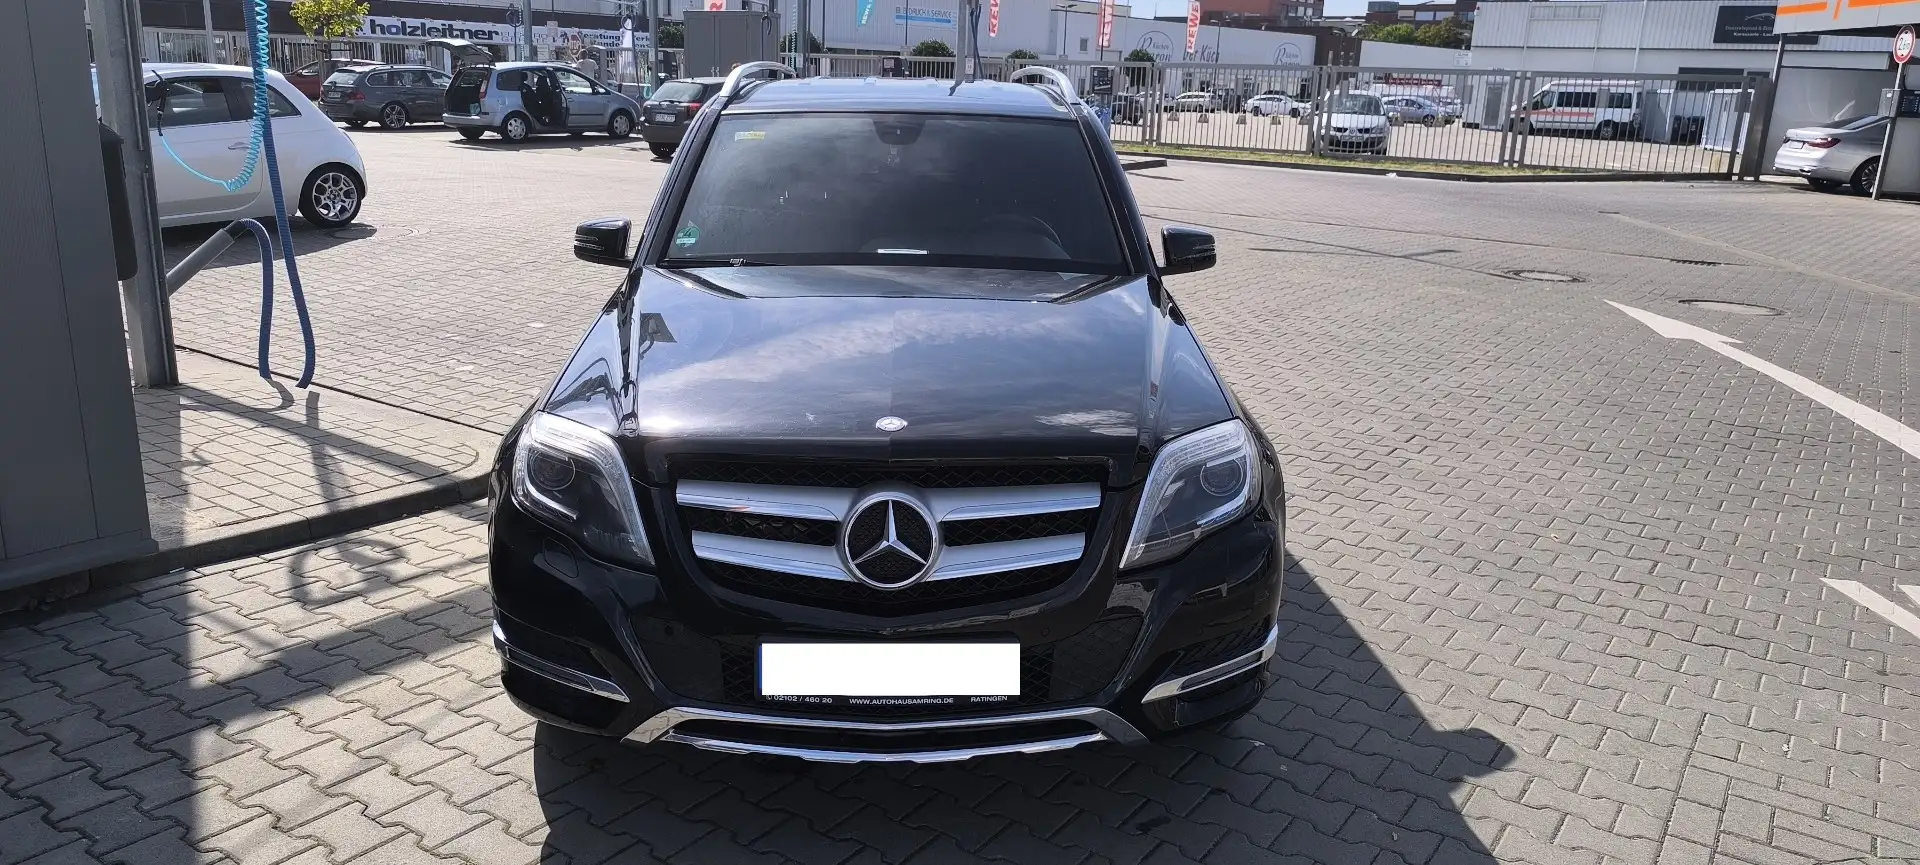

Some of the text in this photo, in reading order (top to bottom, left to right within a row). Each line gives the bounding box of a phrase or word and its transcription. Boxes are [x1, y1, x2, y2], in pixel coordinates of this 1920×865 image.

[931, 9, 952, 19] SERVICE
[369, 18, 500, 41] holzleitner
[1187, 3, 1199, 49] REWE
[773, 694, 798, 702] 02102
[970, 695, 1008, 703] RATINGEN
